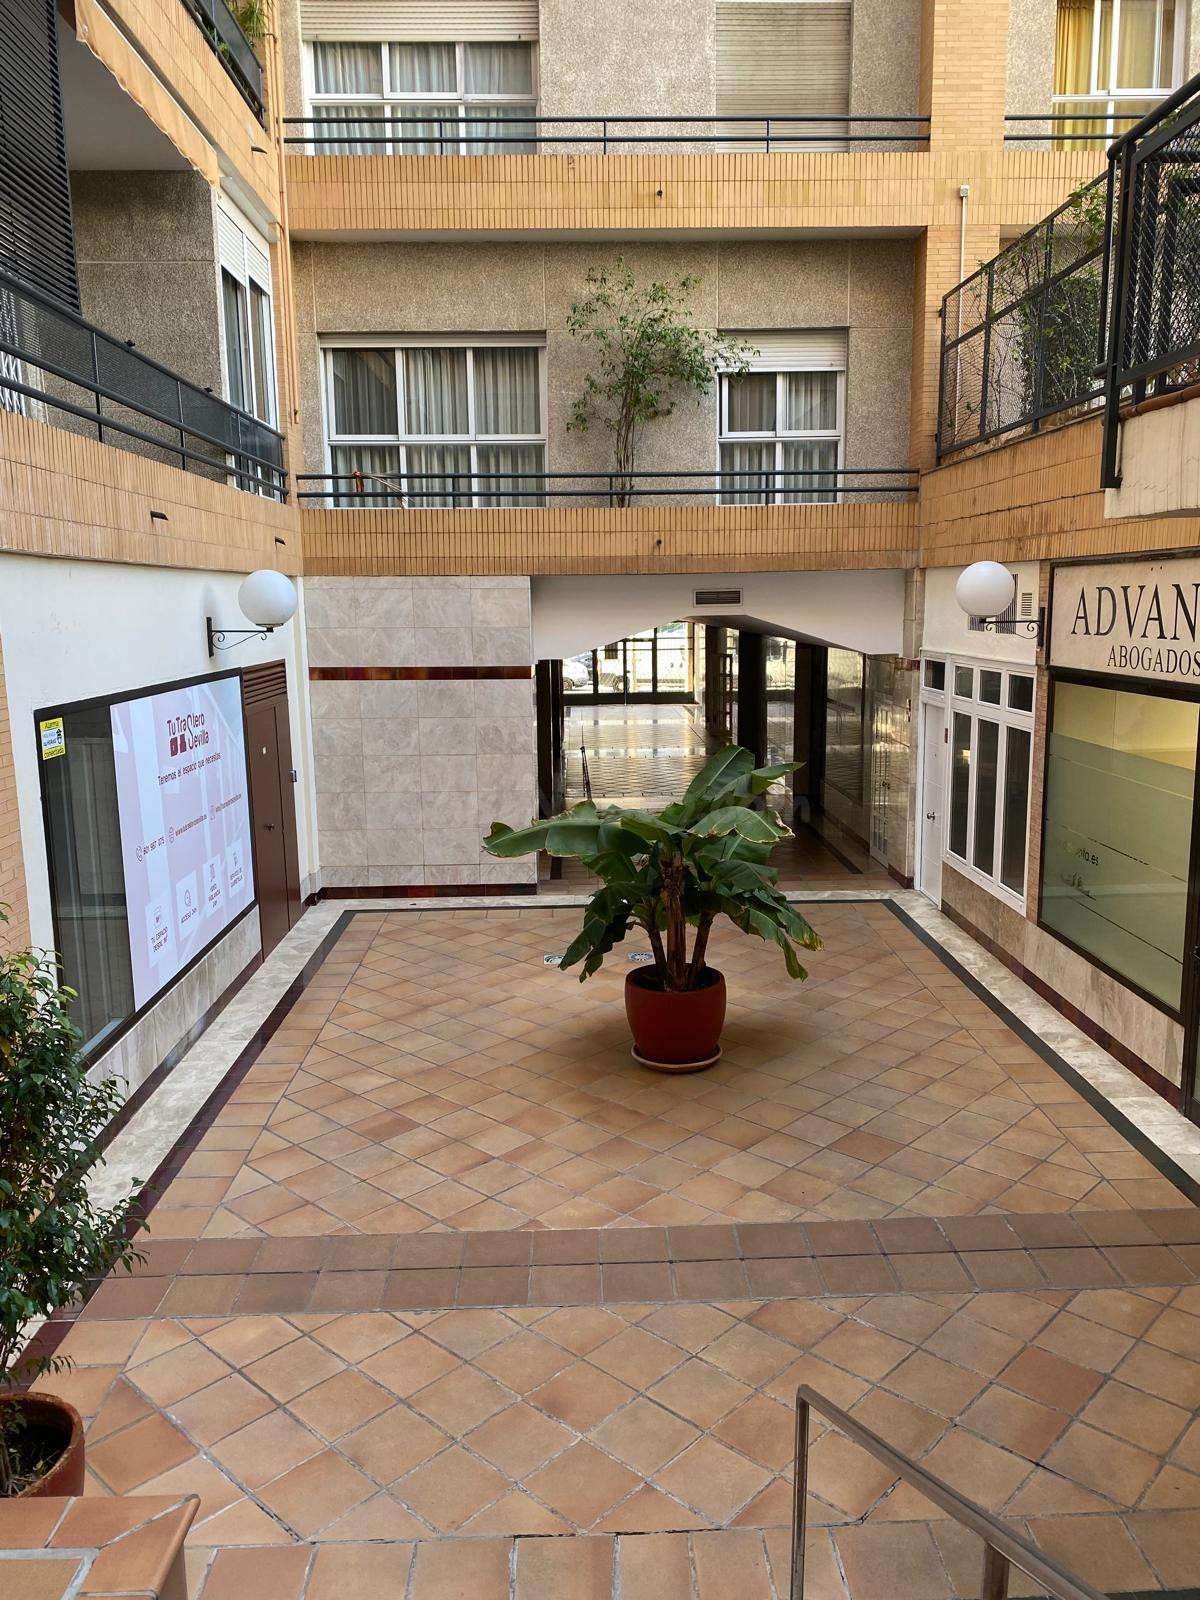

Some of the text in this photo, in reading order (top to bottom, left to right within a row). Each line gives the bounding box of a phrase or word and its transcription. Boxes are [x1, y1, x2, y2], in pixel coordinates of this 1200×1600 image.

[1071, 583, 1200, 642] ADVAN
[1107, 645, 1200, 677] ABOGADOS
[167, 720, 176, 736] Tu
[158, 771, 176, 786] Tenemos
[177, 767, 182, 777] el
[183, 762, 197, 775] espacio
